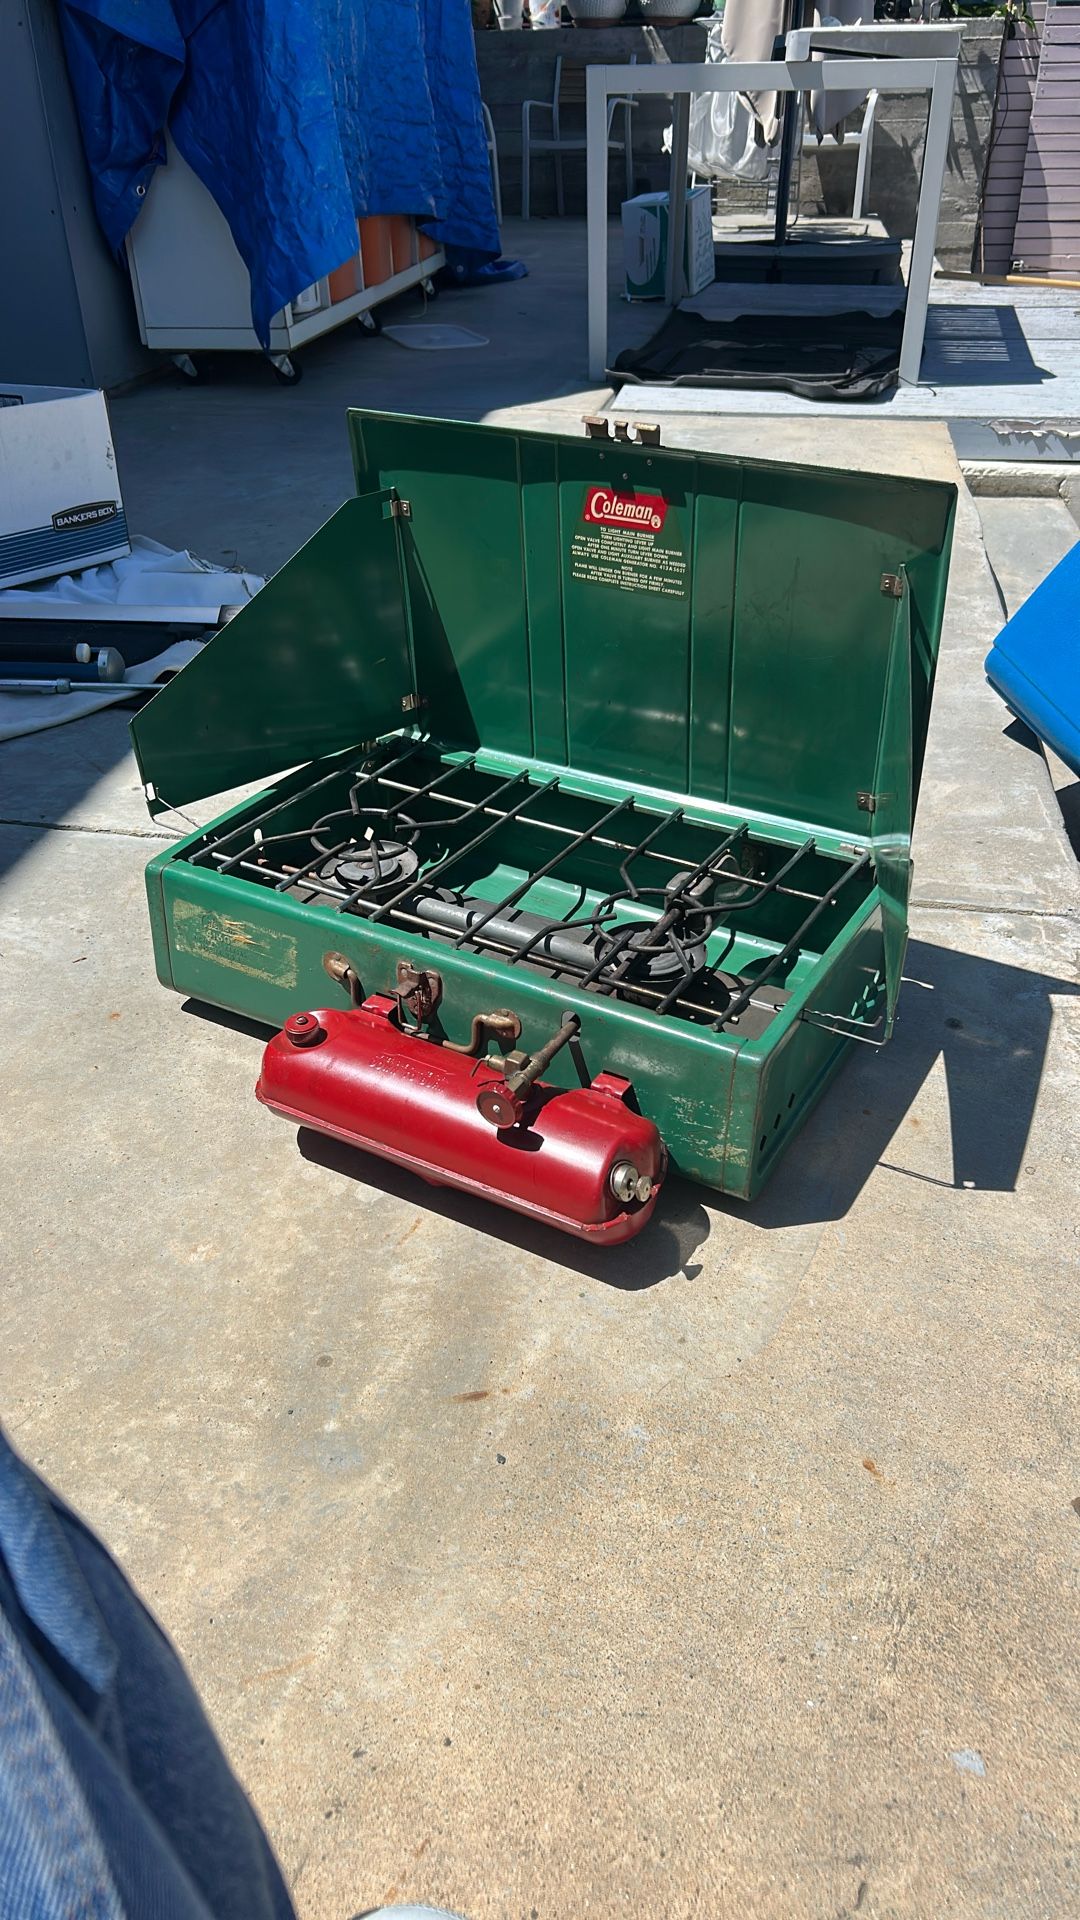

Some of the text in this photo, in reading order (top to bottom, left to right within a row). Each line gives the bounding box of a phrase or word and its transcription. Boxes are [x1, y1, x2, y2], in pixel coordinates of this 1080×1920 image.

[590, 491, 653, 520] Coleman
[56, 506, 115, 526] BANKERS BOX
[601, 539, 626, 548] COMPLETELY
[623, 559, 648, 567] GENERATOR
[620, 580, 647, 589] INSTRUCTION
[662, 587, 684, 596] CAREFULLY
